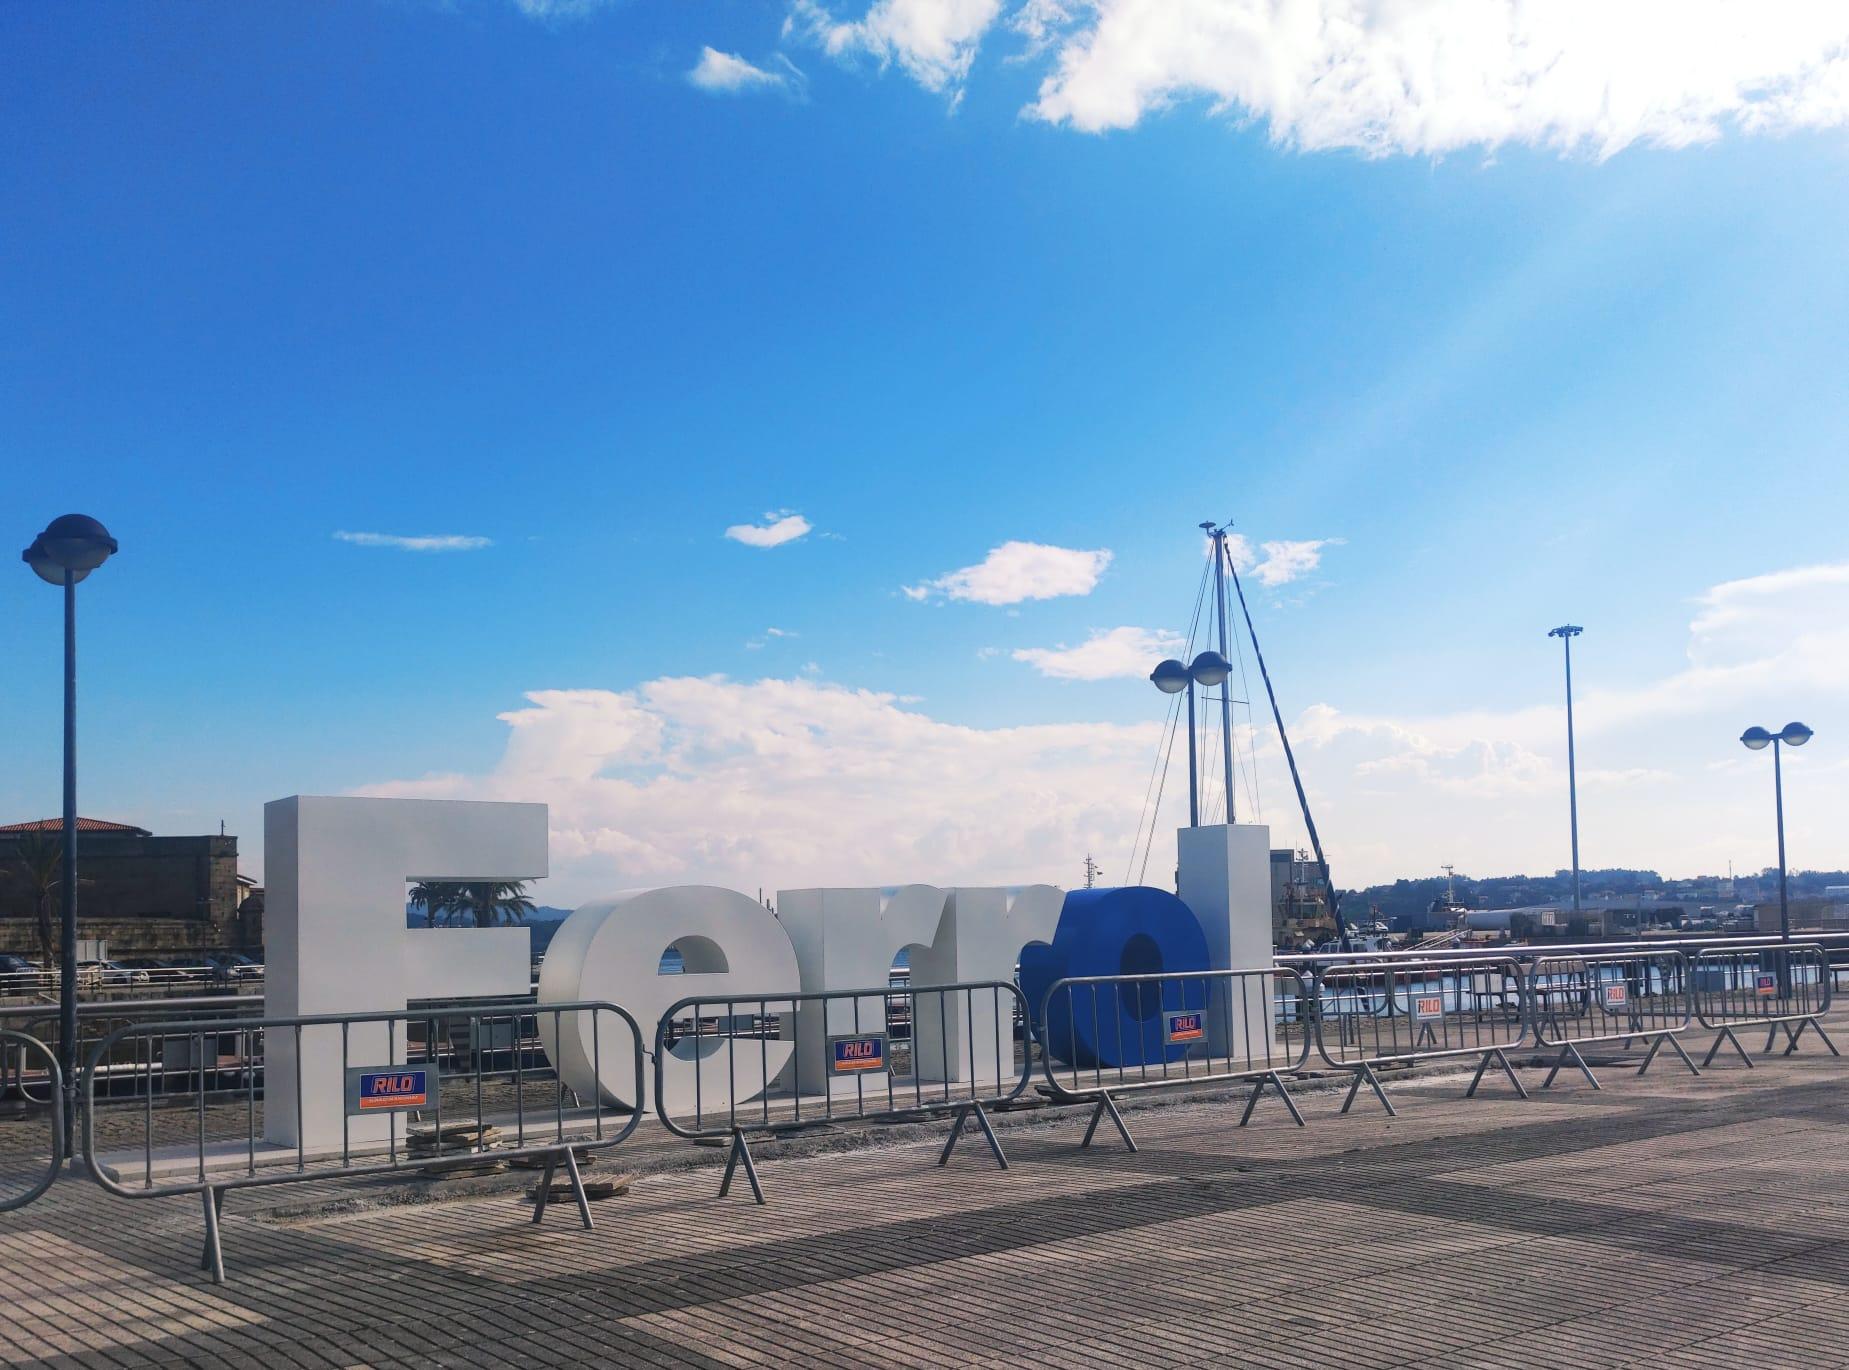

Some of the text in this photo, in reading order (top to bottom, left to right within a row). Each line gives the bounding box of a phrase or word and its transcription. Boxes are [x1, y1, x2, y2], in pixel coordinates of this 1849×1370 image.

[264, 796, 1274, 1158] Ferrol
[1418, 999, 1440, 1013] RILO
[1176, 1016, 1195, 1031] RILO
[844, 1042, 873, 1057] RILO
[373, 1075, 414, 1093] RILO
